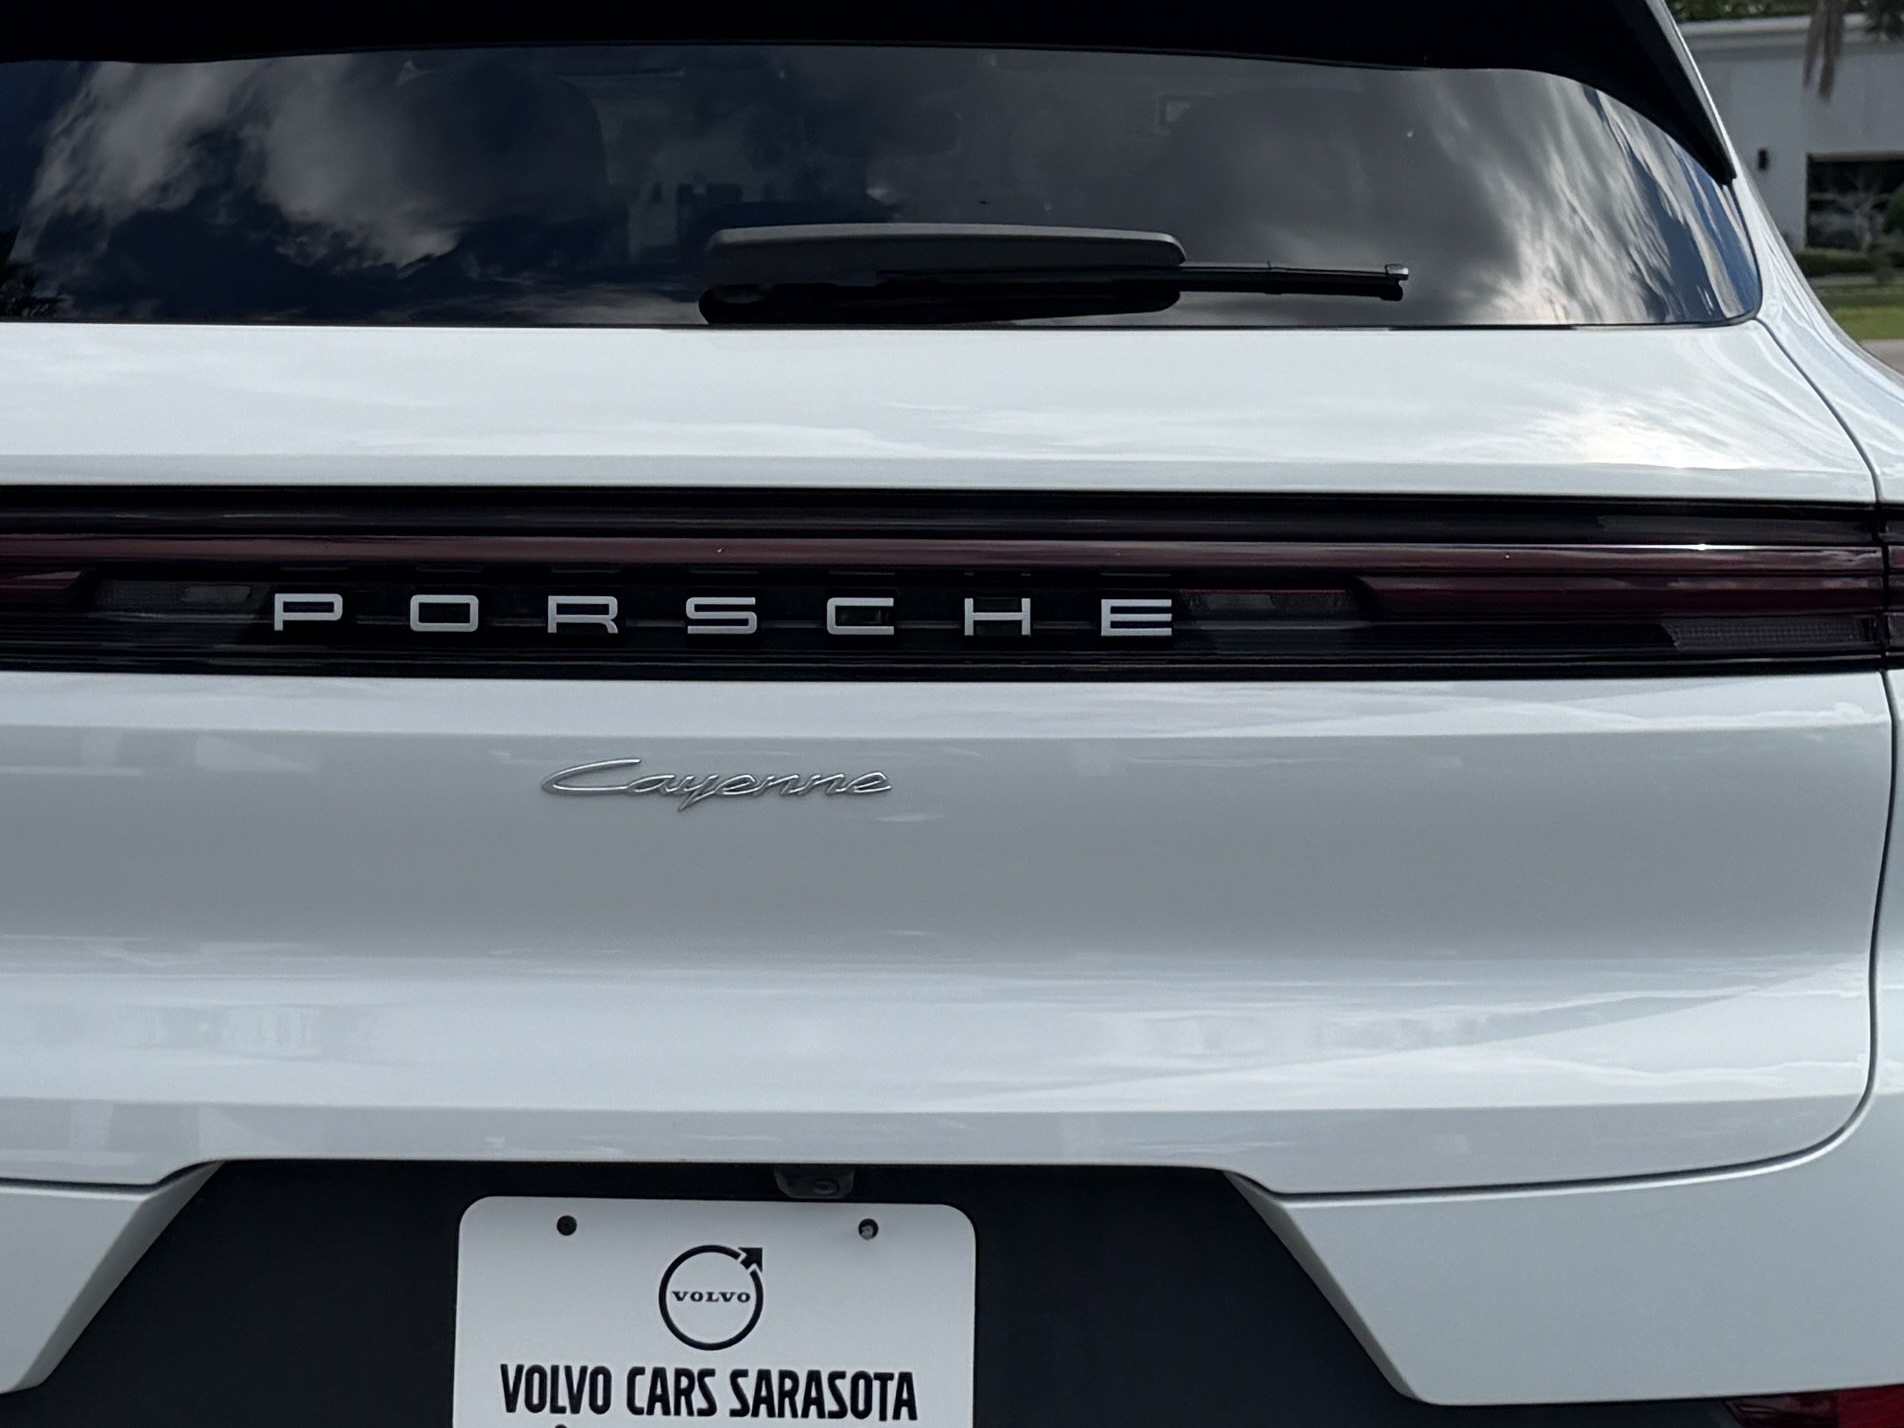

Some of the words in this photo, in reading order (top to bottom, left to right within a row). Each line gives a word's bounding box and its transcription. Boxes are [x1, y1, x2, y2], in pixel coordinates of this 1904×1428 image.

[274, 593, 1173, 636] PORSCHE
[540, 758, 893, 812] Cayenne
[671, 1290, 751, 1304] VOLVO
[500, 1363, 612, 1415] VOLVO
[626, 1366, 718, 1417] CARS
[729, 1368, 918, 1422] SARASOTA
